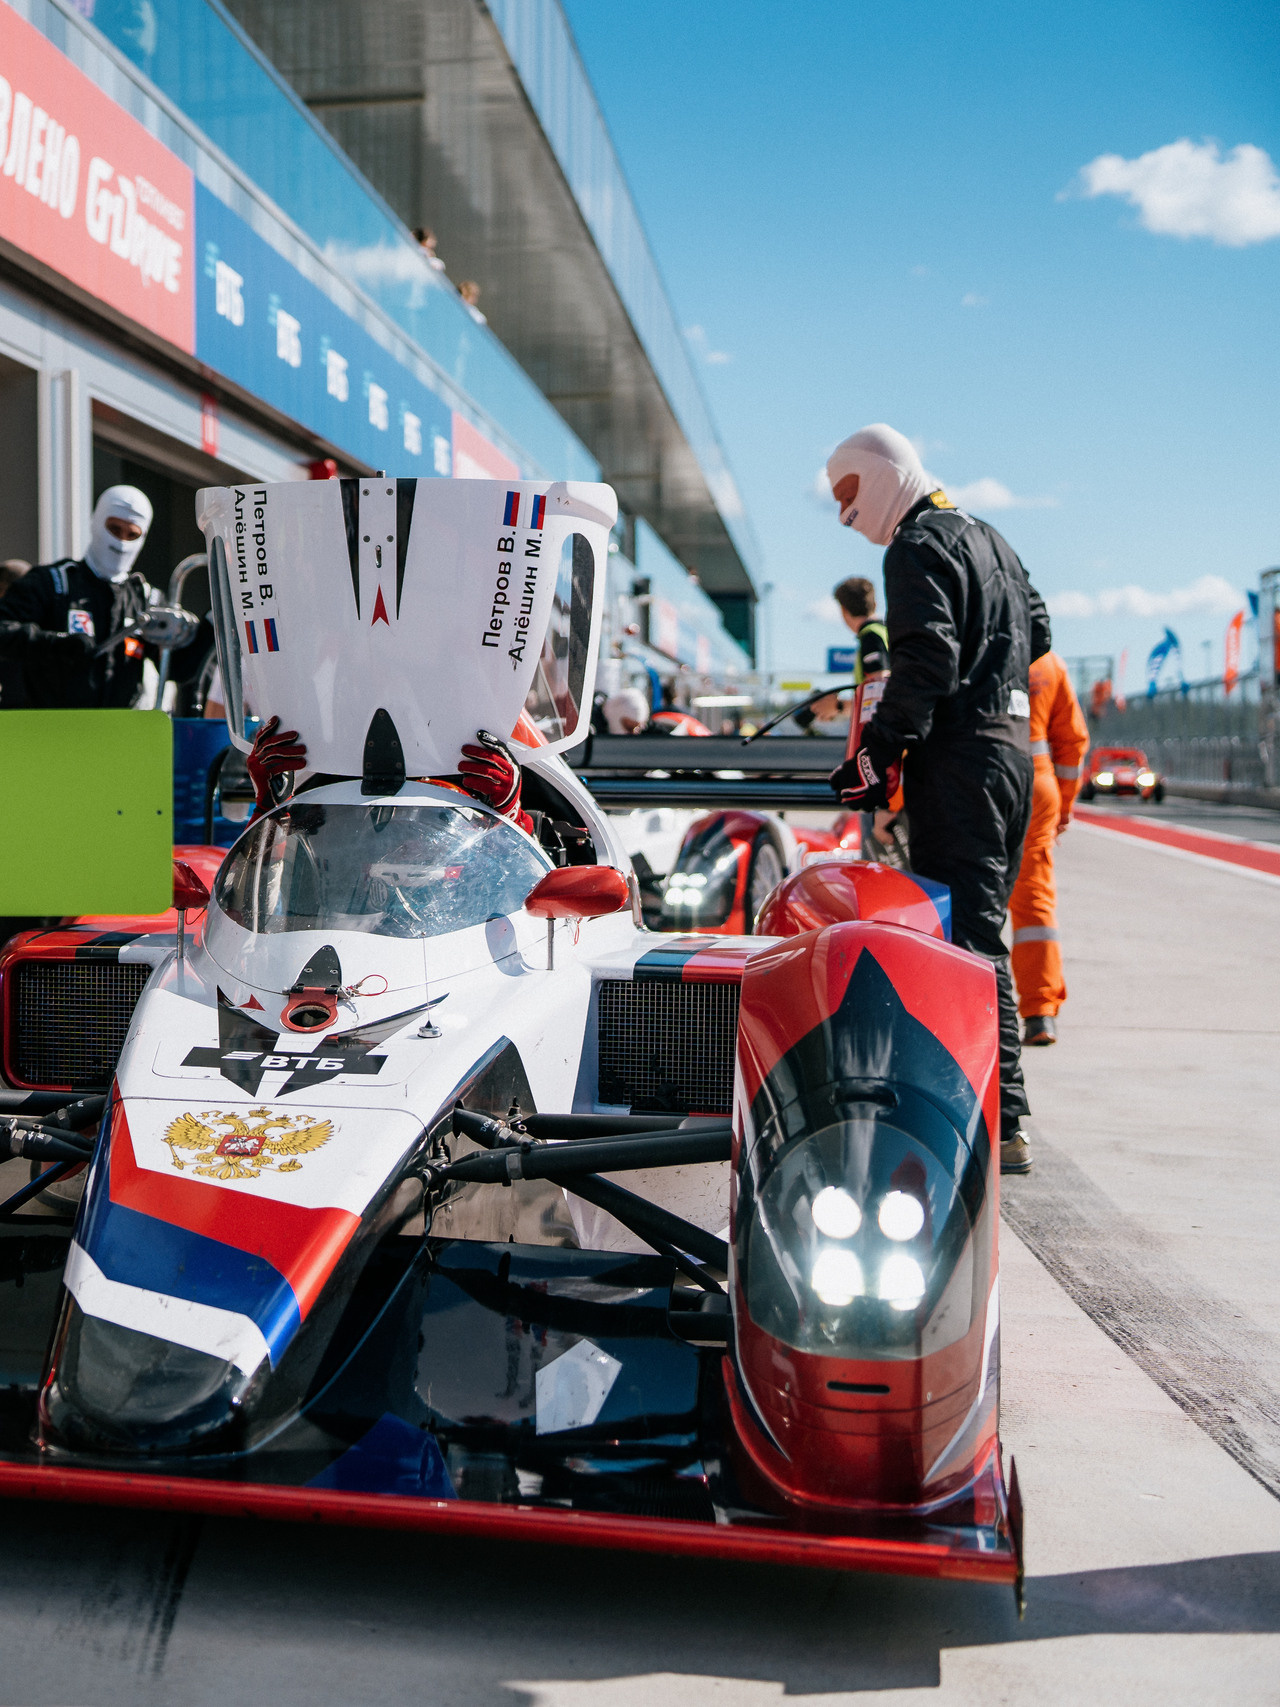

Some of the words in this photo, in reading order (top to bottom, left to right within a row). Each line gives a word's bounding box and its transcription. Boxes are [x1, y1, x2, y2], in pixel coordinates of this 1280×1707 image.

[234, 489, 248, 583] Алёшин
[241, 591, 254, 616] М.
[252, 490, 268, 576] Петров
[259, 584, 273, 606] В.
[482, 561, 512, 647] Петров
[497, 530, 516, 553] В.
[508, 566, 538, 662] Алёшин
[524, 533, 543, 558] М.
[260, 1055, 346, 1071] ВТБ
